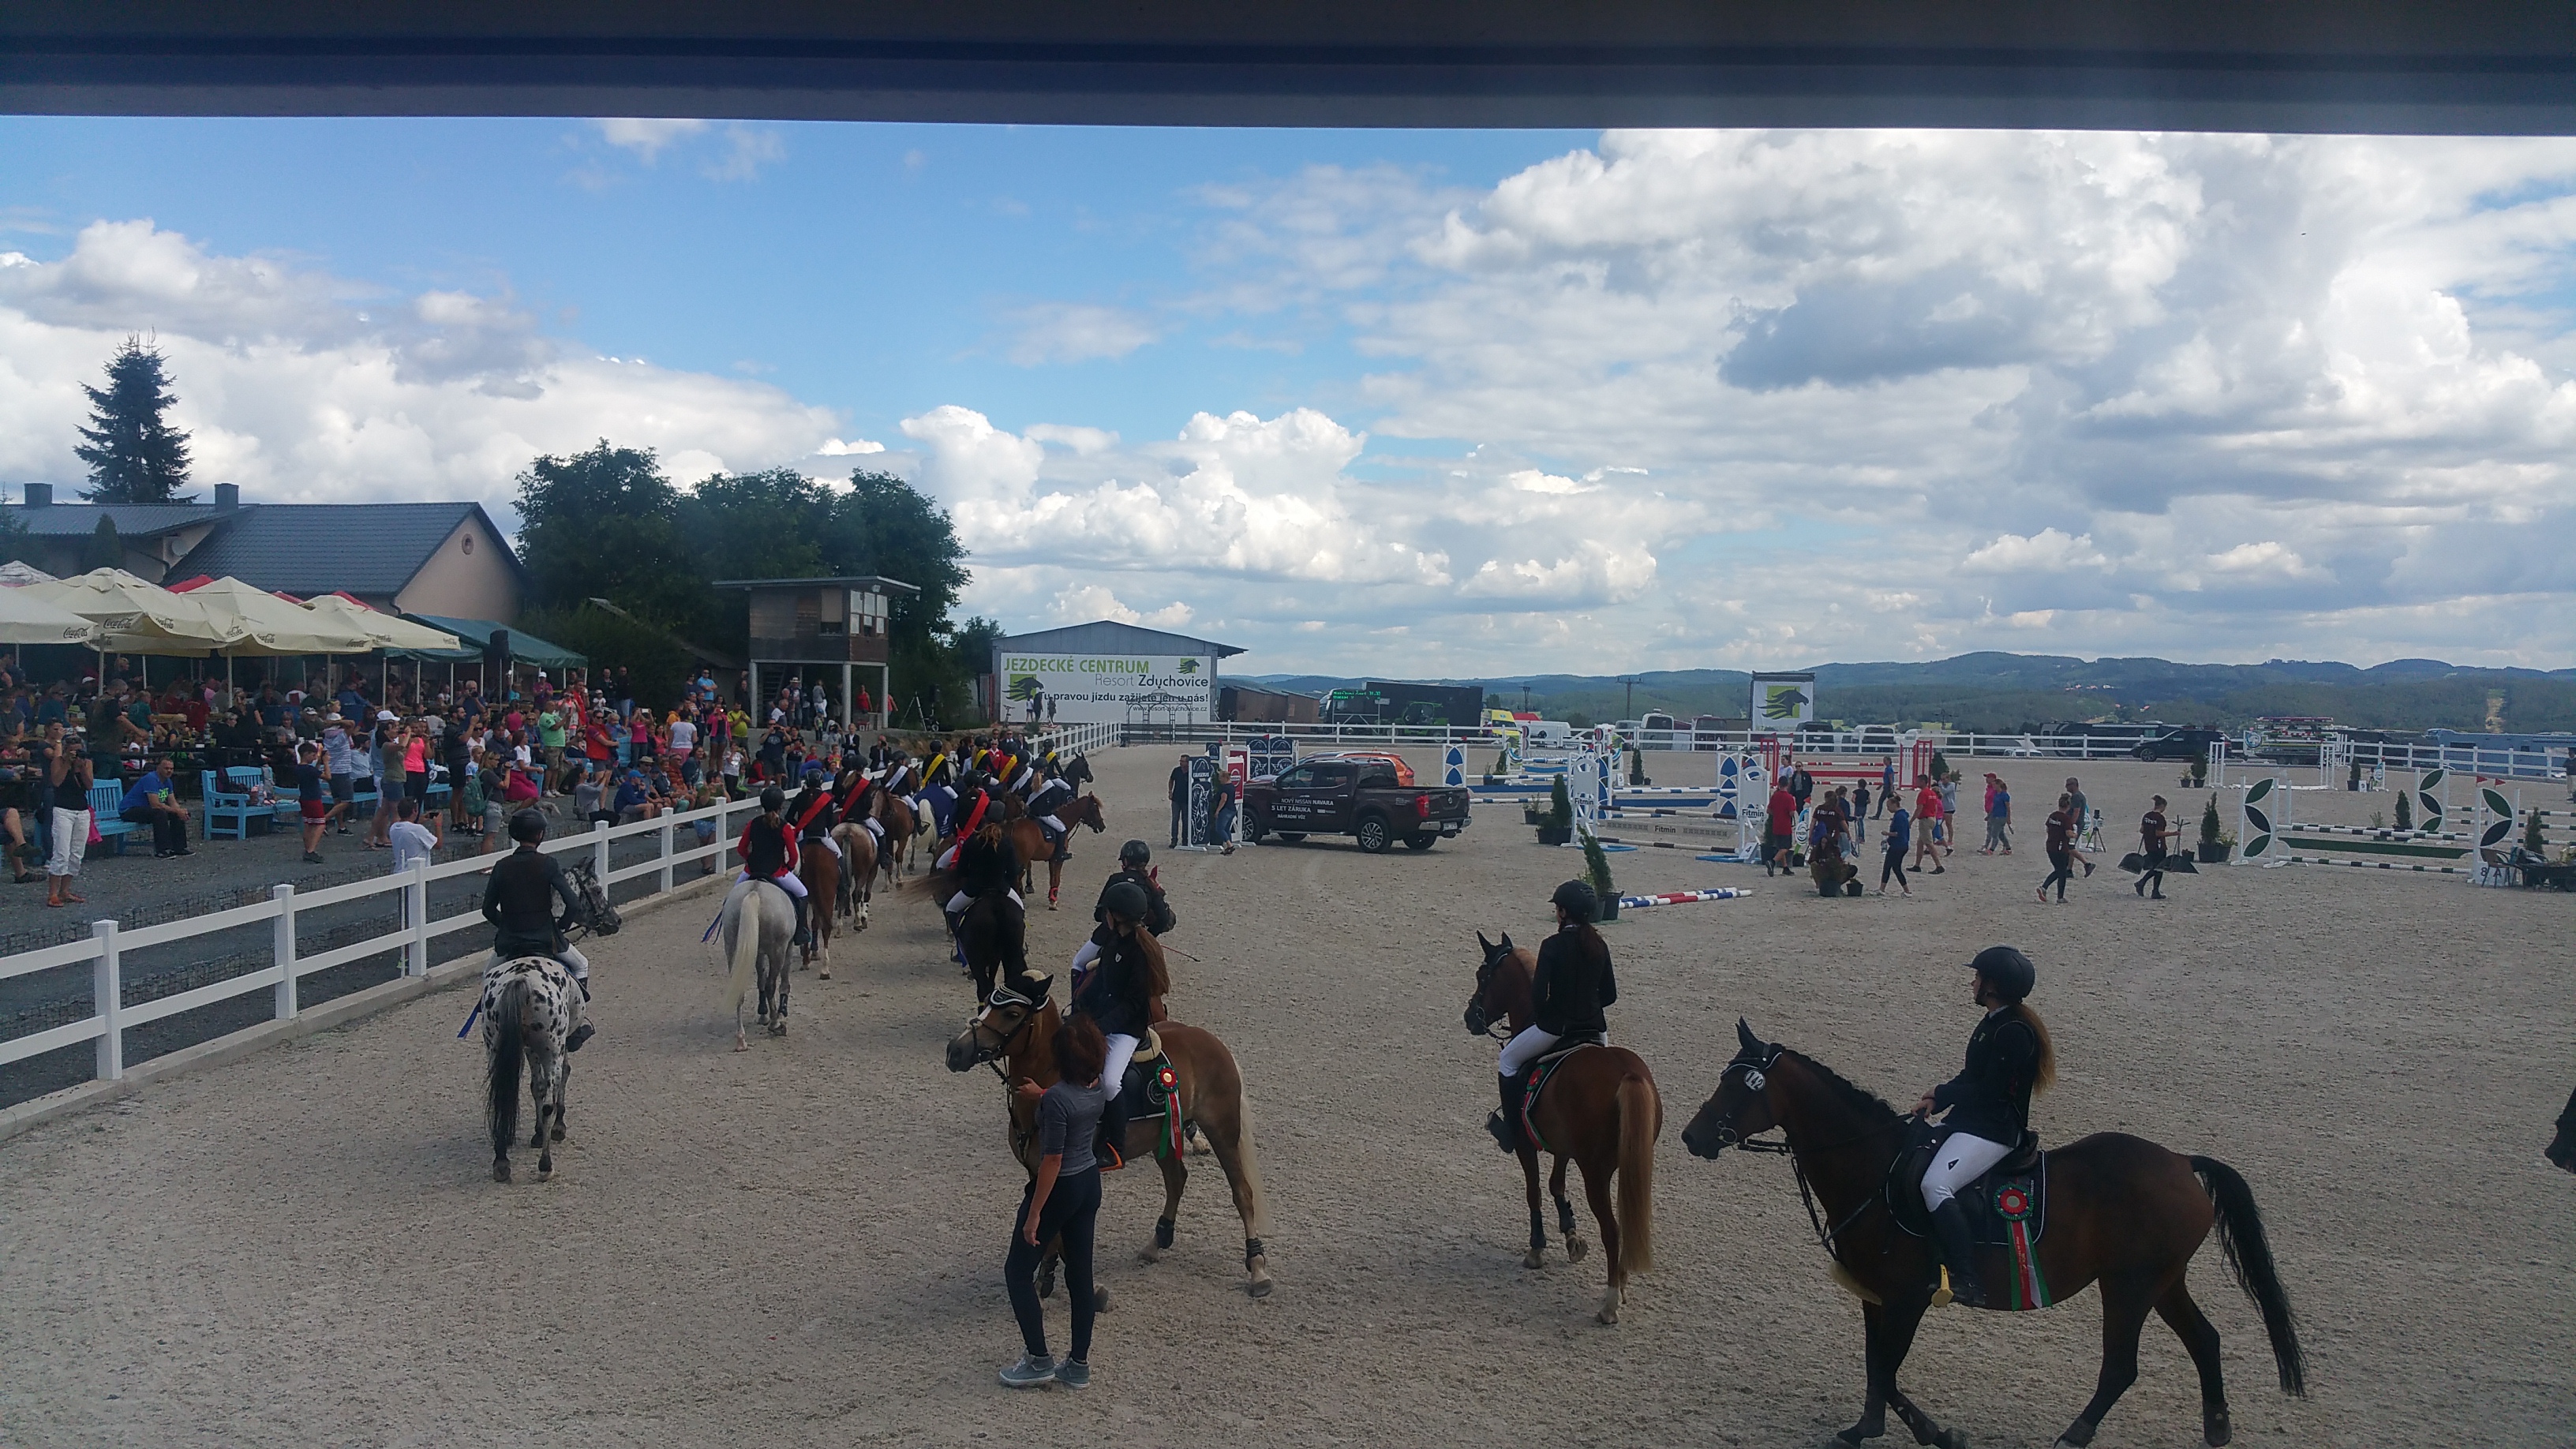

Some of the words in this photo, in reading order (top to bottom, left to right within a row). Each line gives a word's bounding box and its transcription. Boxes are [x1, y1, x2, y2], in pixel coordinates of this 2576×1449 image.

[103, 618, 133, 629] Coca-Cola
[155, 618, 174, 629] oca-Cola
[63, 627, 88, 638] Coca-Cola
[1004, 656, 1074, 672] JEZDECKÉ
[1079, 659, 1149, 674] CENTRUM
[1095, 673, 1134, 687] Resort
[1138, 674, 1208, 687] Zduchovice
[1091, 692, 1116, 703] jízdu
[1118, 693, 1157, 703] zažijete
[1187, 693, 1208, 702] nás!
[1574, 797, 1594, 806] Fitmin
[1288, 804, 1312, 813] ZÁRUKA
[1742, 809, 1765, 818] Fitmin
[2481, 867, 2488, 876] 8
[1746, 1072, 1764, 1090] 142
